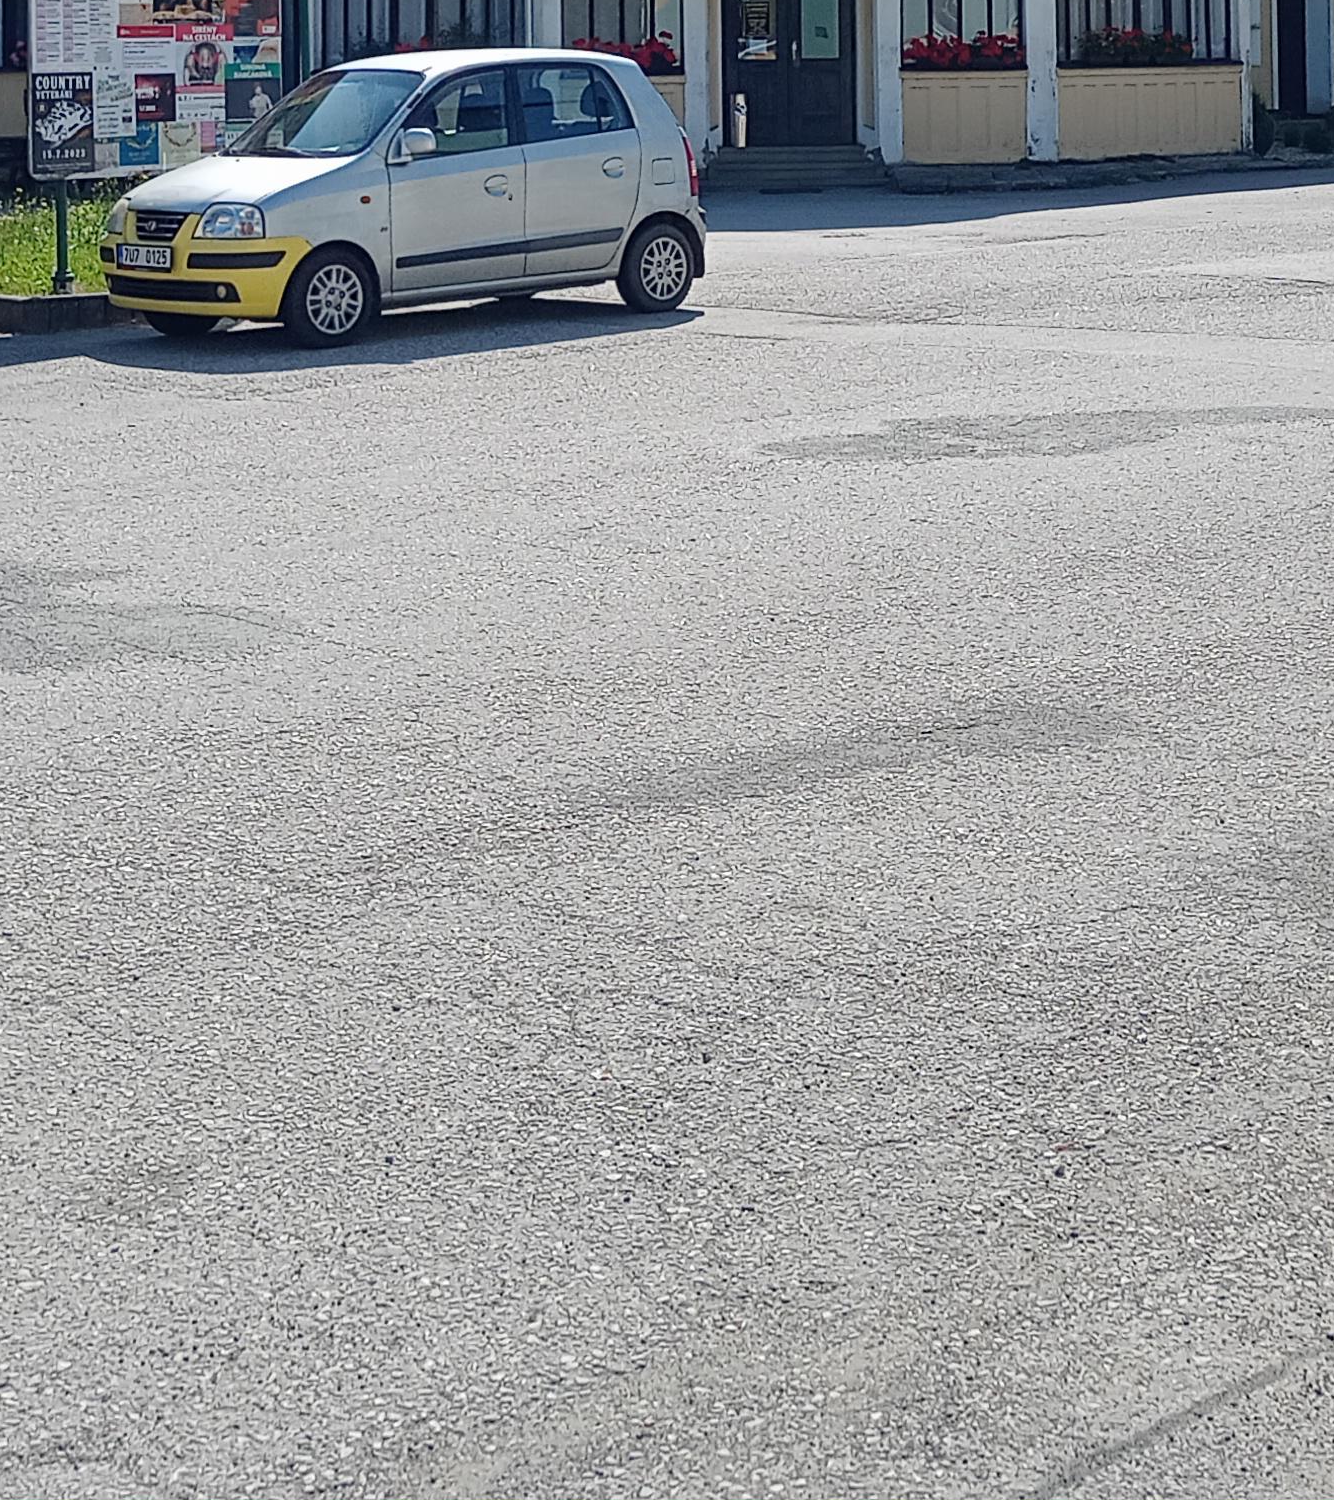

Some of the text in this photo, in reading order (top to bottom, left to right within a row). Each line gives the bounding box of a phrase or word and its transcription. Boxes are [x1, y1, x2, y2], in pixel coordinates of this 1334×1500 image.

[35, 75, 91, 90] COUNTRY
[124, 247, 167, 265] 7U7 0125
